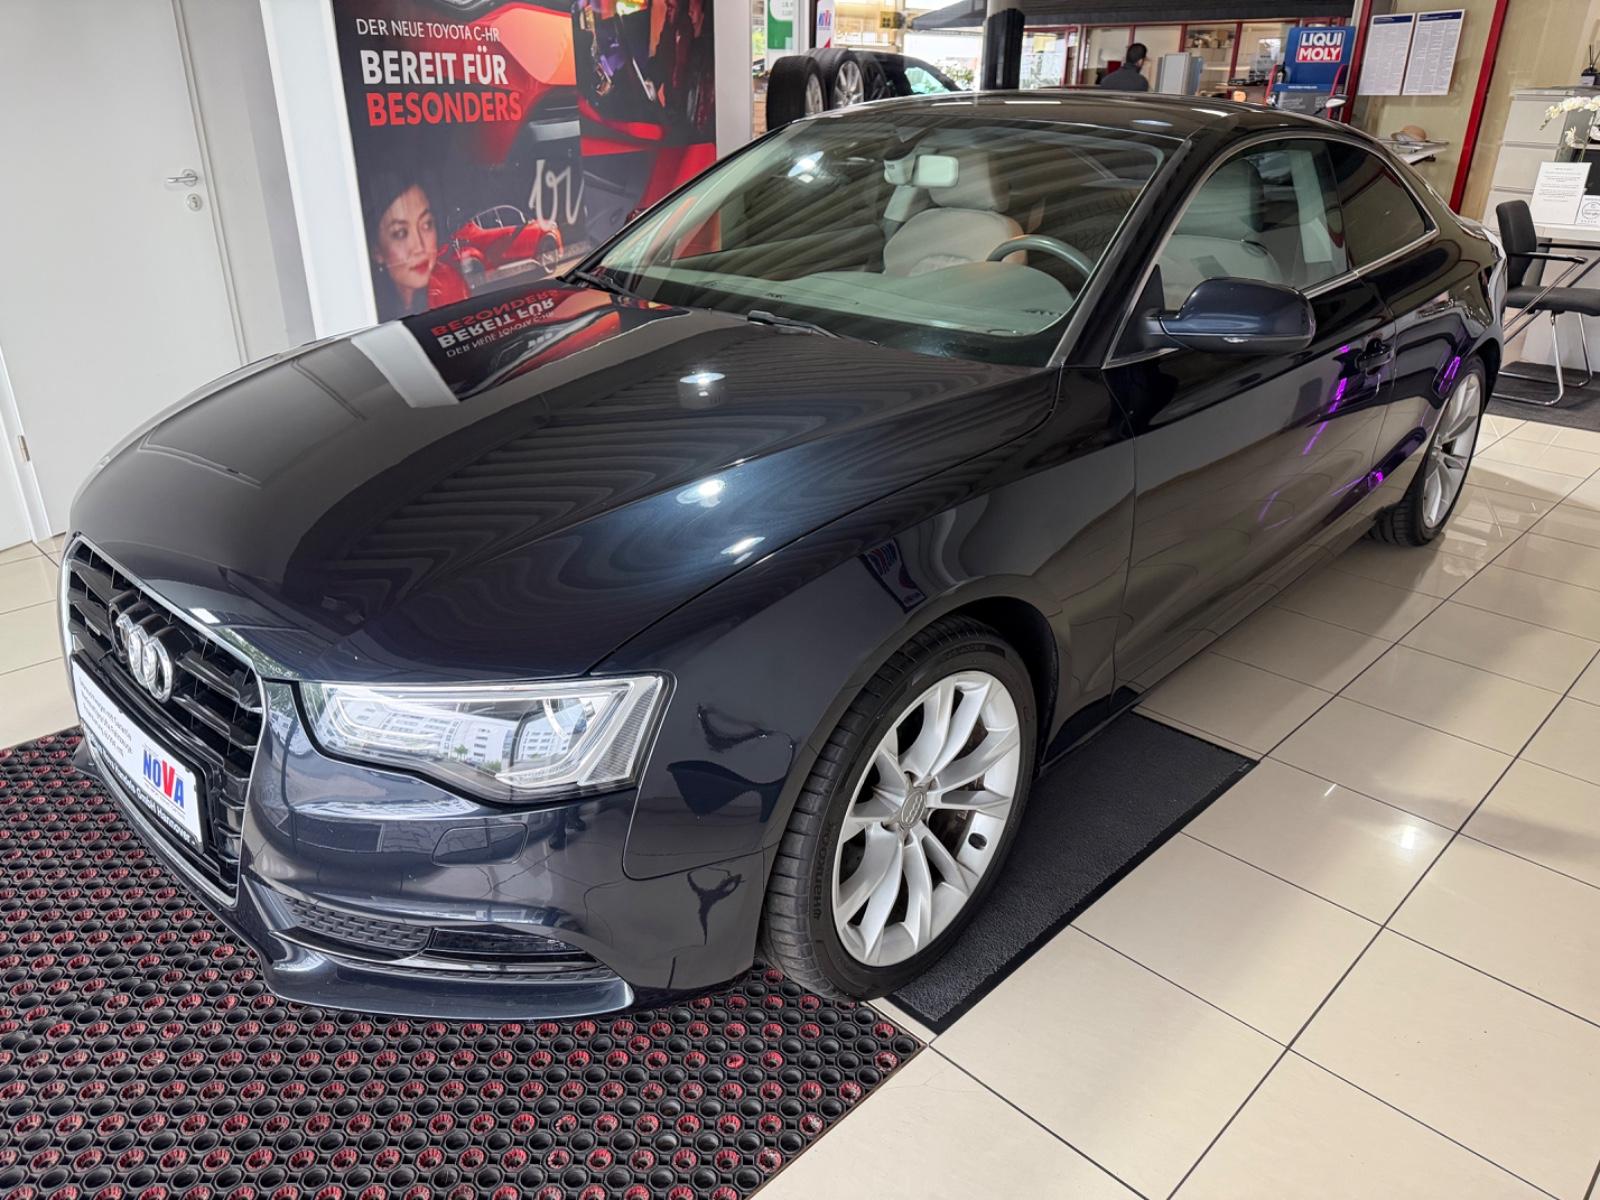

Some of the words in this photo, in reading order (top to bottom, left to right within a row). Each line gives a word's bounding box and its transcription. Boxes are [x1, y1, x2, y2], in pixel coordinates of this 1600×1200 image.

[356, 18, 388, 36] DER
[391, 20, 424, 38] NEUE
[426, 22, 471, 40] TOYOTA
[474, 27, 500, 42] C-HR
[1301, 32, 1343, 46] LIQUI
[360, 49, 457, 85] BEREIT
[462, 45, 509, 85] FÜR
[1299, 47, 1341, 61] MOLY
[366, 91, 523, 127] BESONDERS
[143, 750, 184, 809] NOVA
